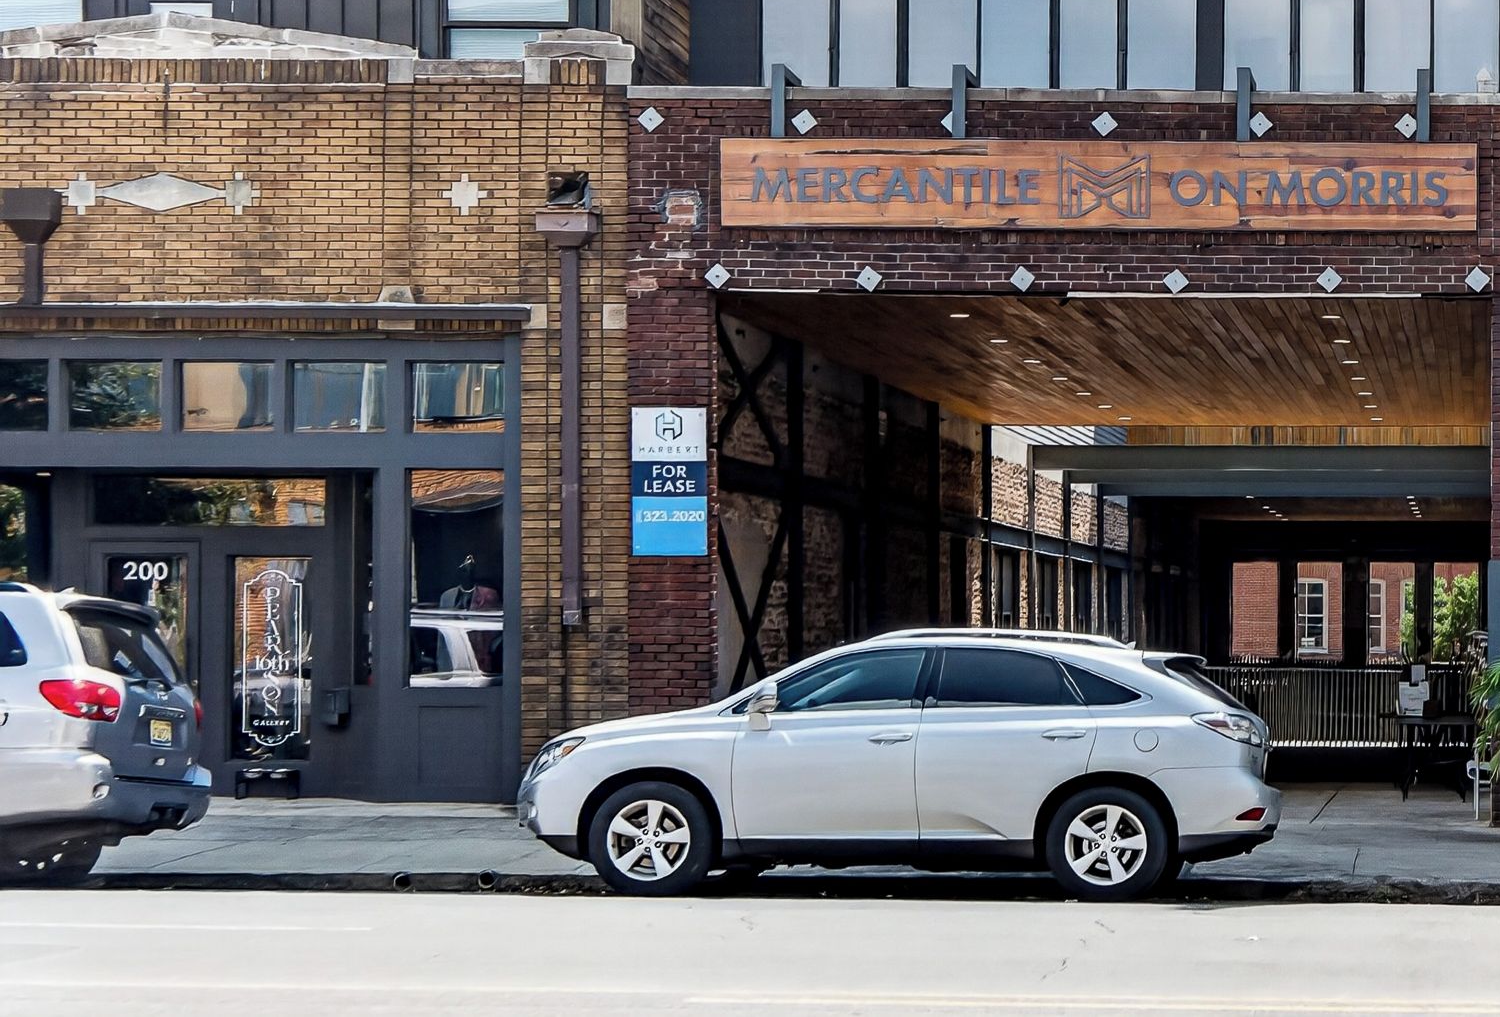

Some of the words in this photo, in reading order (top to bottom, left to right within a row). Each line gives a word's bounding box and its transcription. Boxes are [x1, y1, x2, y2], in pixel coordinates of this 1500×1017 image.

[752, 166, 1040, 205] MERCANTILE
[1170, 169, 1248, 207] ON
[1264, 168, 1449, 208] MORRIS
[652, 465, 687, 478] FOR
[643, 480, 696, 493] LEASE
[123, 561, 168, 581] 200
